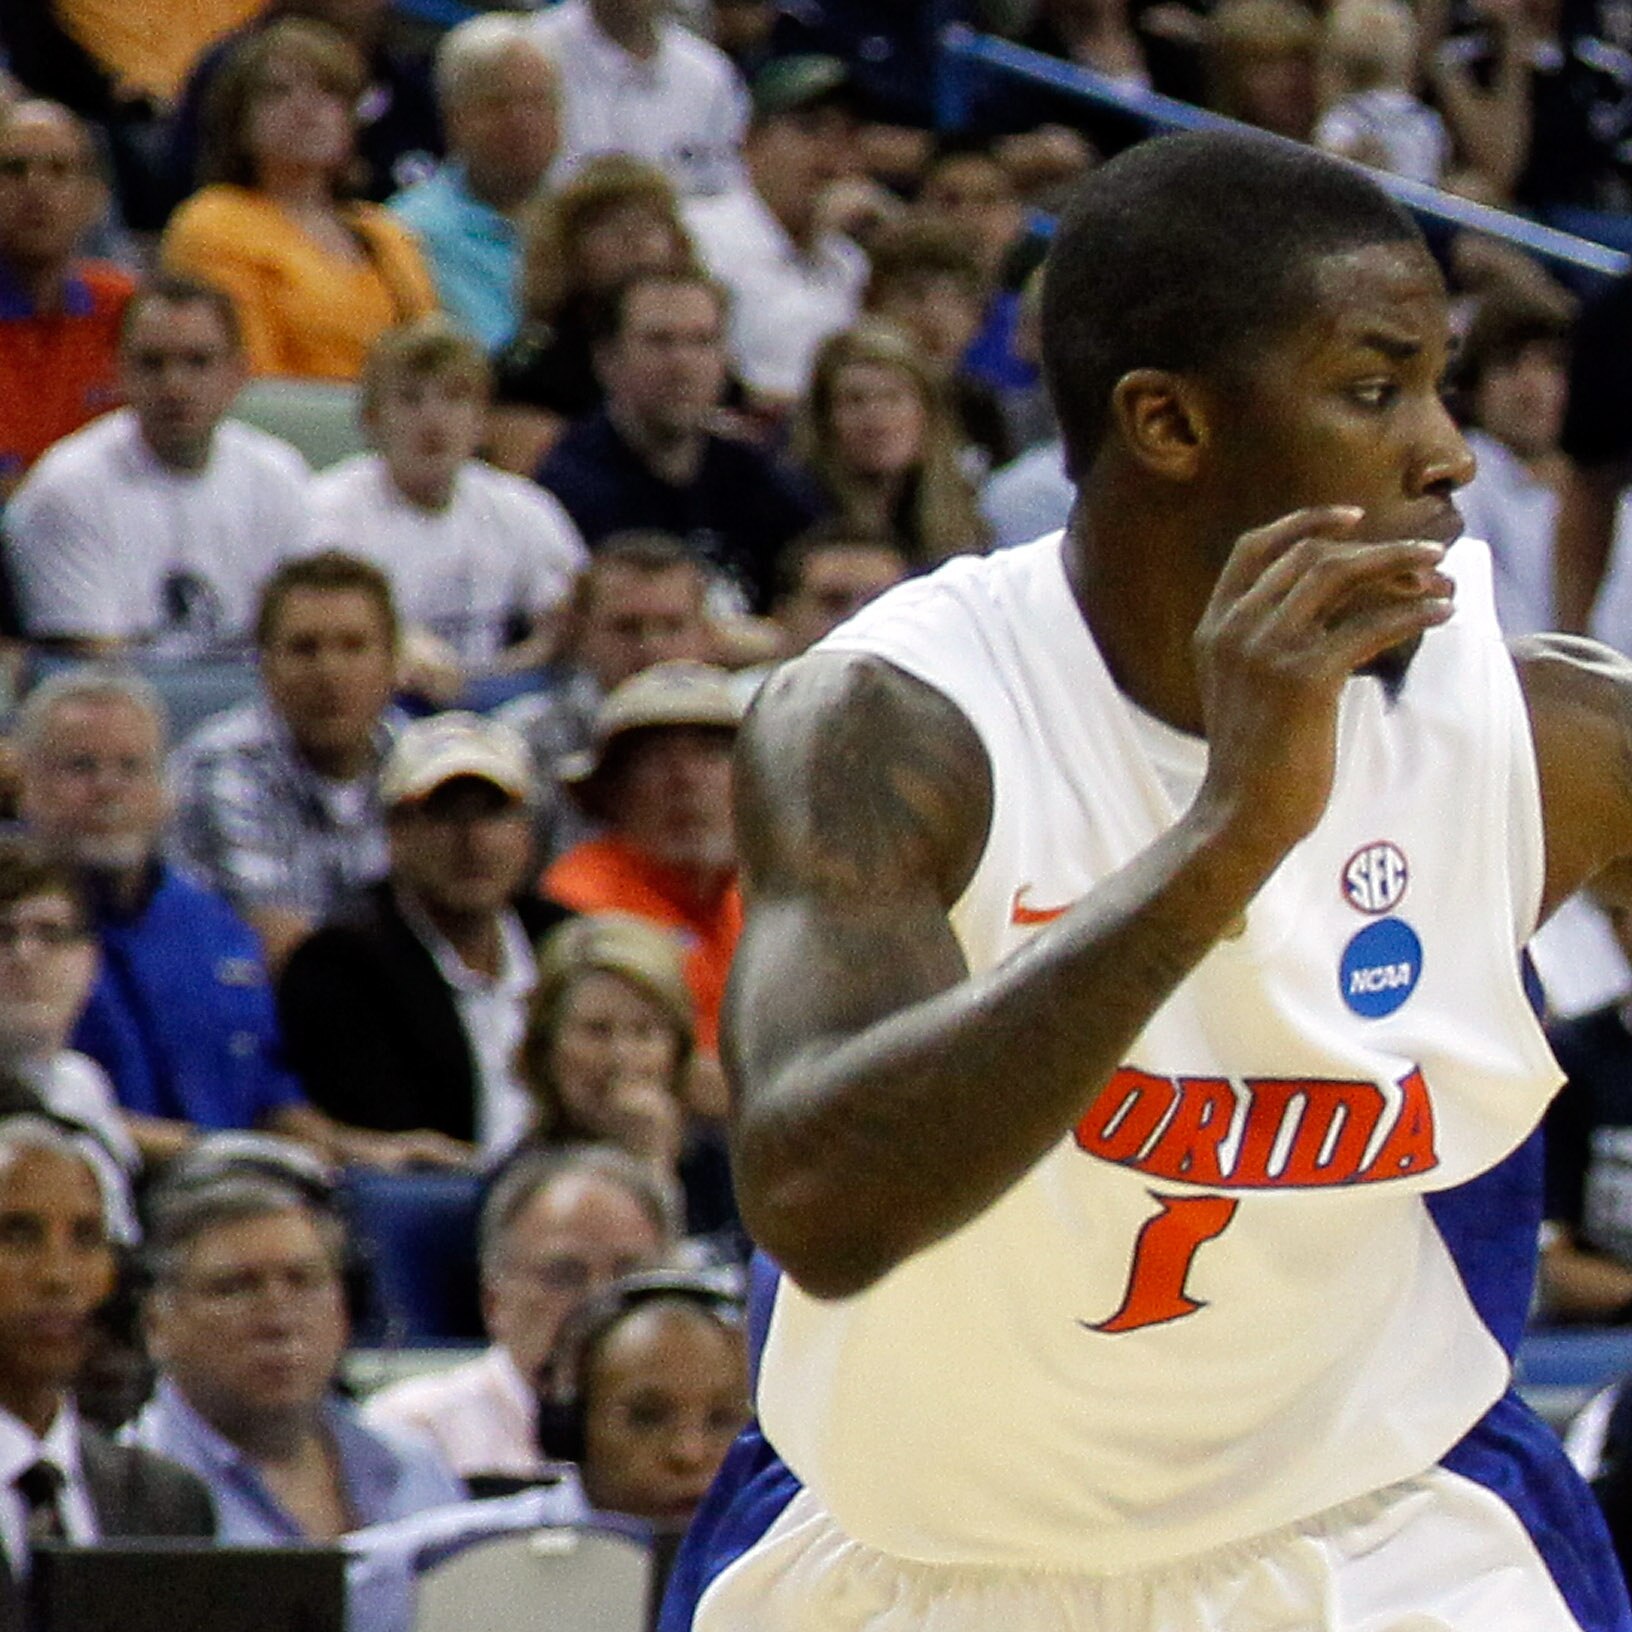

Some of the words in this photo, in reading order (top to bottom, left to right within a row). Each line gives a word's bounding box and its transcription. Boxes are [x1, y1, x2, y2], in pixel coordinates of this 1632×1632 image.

[1346, 846, 1407, 912] SEC
[1350, 962, 1412, 995] NCAA
[1074, 1062, 1440, 1190] ORIDA
[1078, 1188, 1242, 1333] 1
